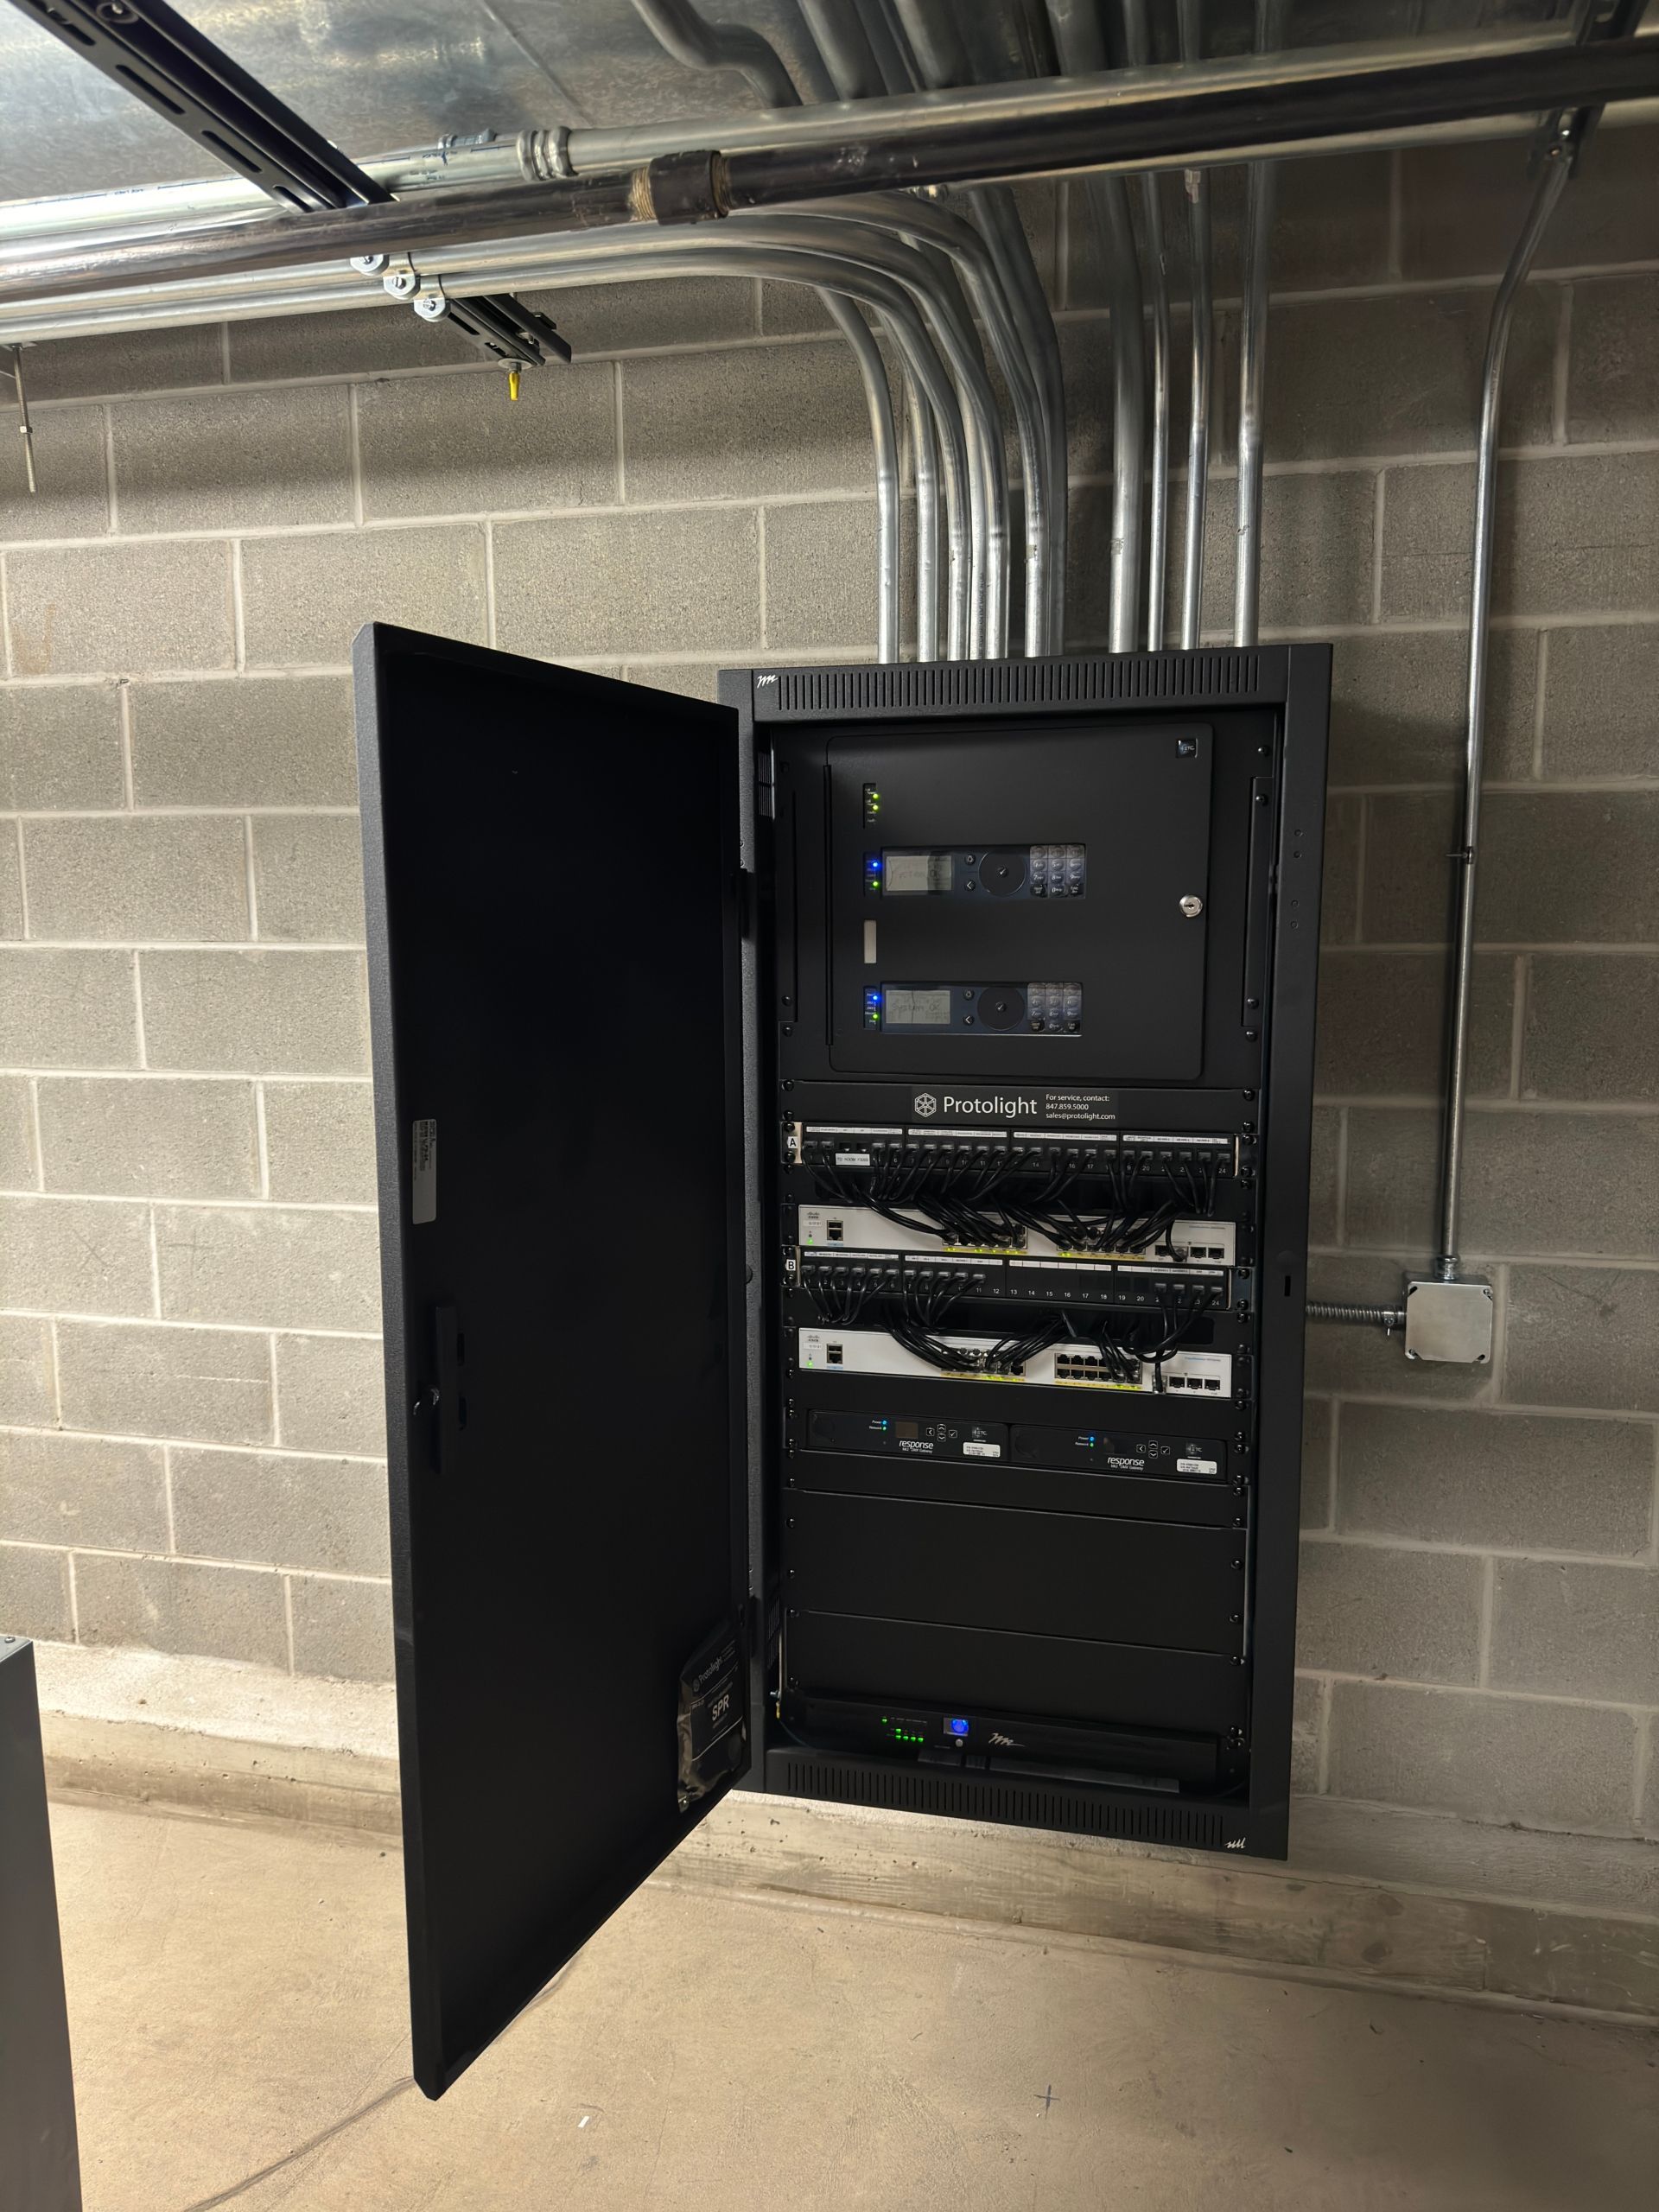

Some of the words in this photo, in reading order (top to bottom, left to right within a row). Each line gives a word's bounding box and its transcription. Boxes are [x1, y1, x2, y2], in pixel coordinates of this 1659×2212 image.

[944, 1096, 1037, 1118] Protolight
[790, 1138, 796, 1147] A
[899, 1440, 933, 1450] response
[1108, 1457, 1145, 1466] response
[698, 1656, 722, 1683] Protolight
[712, 1694, 729, 1721] SPR
